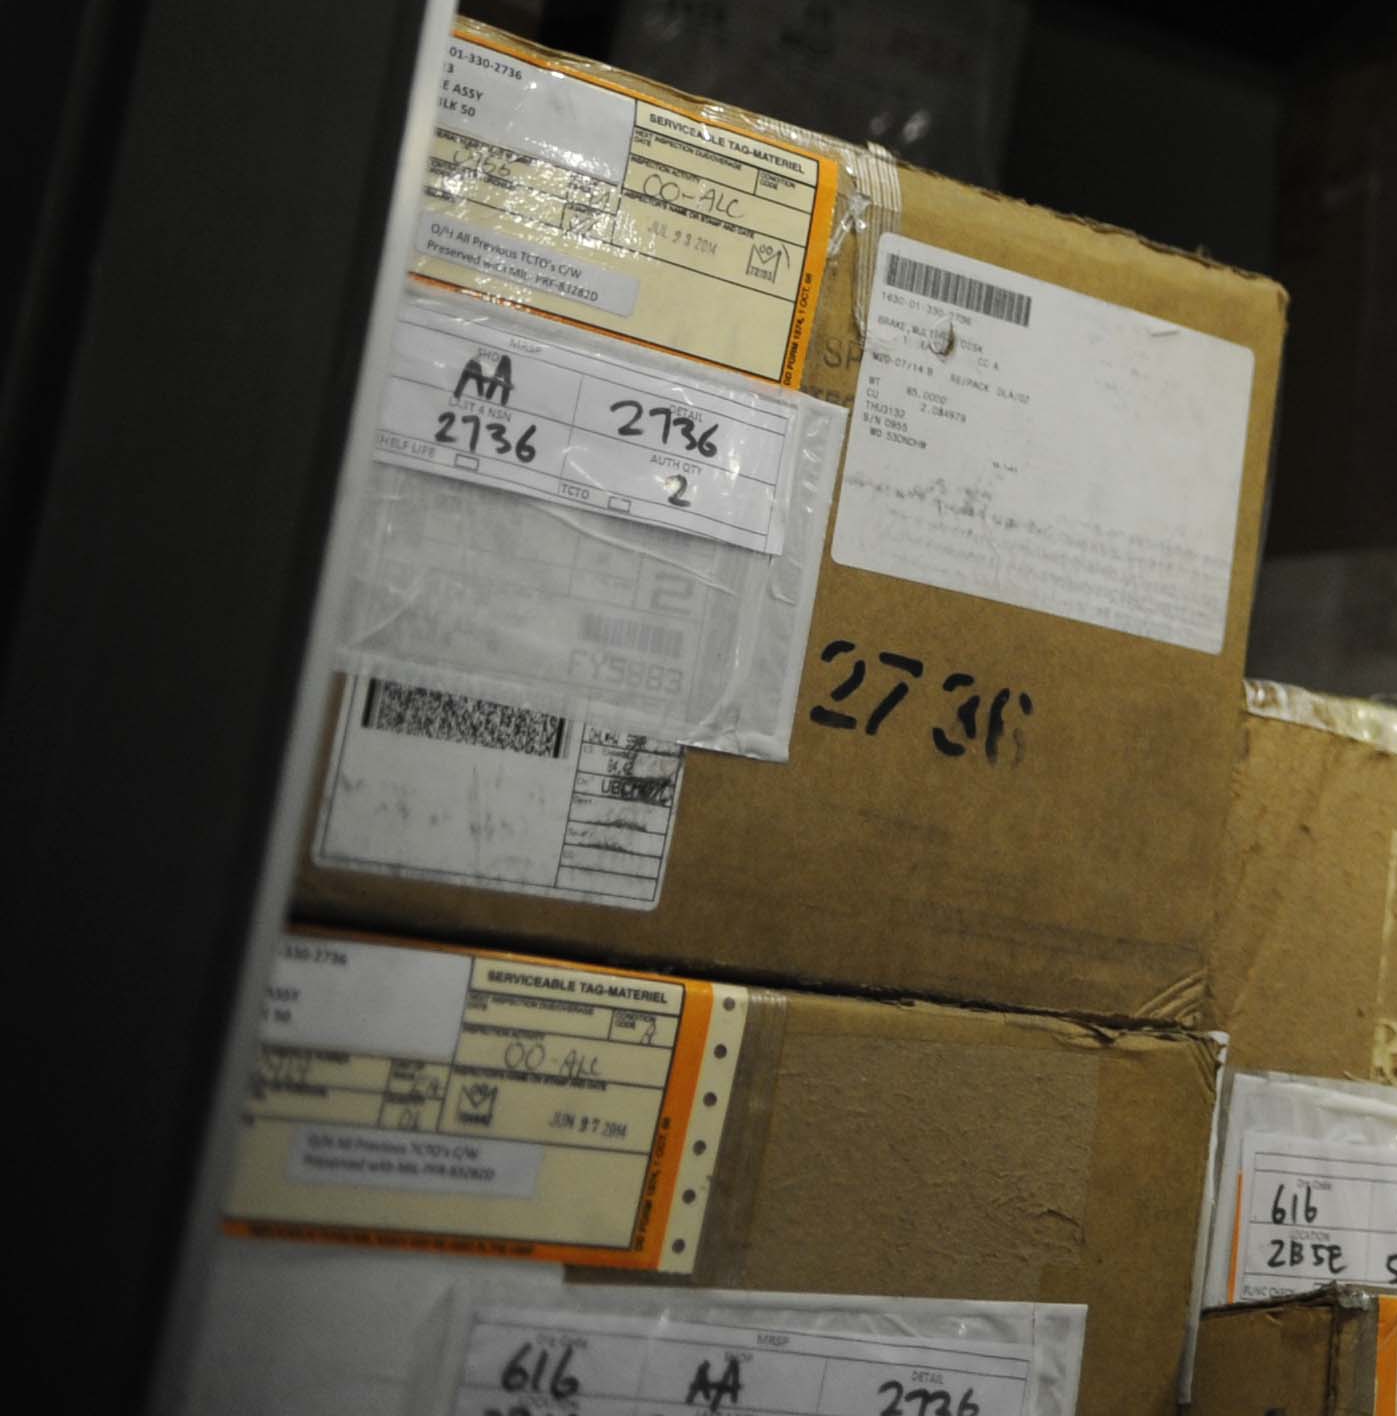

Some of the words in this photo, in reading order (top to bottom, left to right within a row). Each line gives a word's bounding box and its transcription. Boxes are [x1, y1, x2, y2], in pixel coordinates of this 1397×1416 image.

[452, 83, 485, 102] ASSY
[460, 103, 476, 118] 50
[728, 138, 805, 174] TAG-MATERIEL
[427, 239, 482, 266] Preserved
[456, 231, 470, 244] All
[472, 235, 518, 260] Previous
[558, 263, 582, 280] C/W
[453, 354, 516, 407] AA
[434, 411, 537, 464] 2736
[609, 399, 719, 458] 2736
[411, 442, 437, 458] LIFE
[650, 453, 680, 470] AUTH
[667, 473, 692, 508] 2
[487, 970, 576, 993] SERVICEABLE
[580, 981, 669, 1005] TAG-MATERIEL
[1271, 1183, 1318, 1225] 616
[501, 1341, 580, 1401] 616
[684, 1357, 742, 1412] AA
